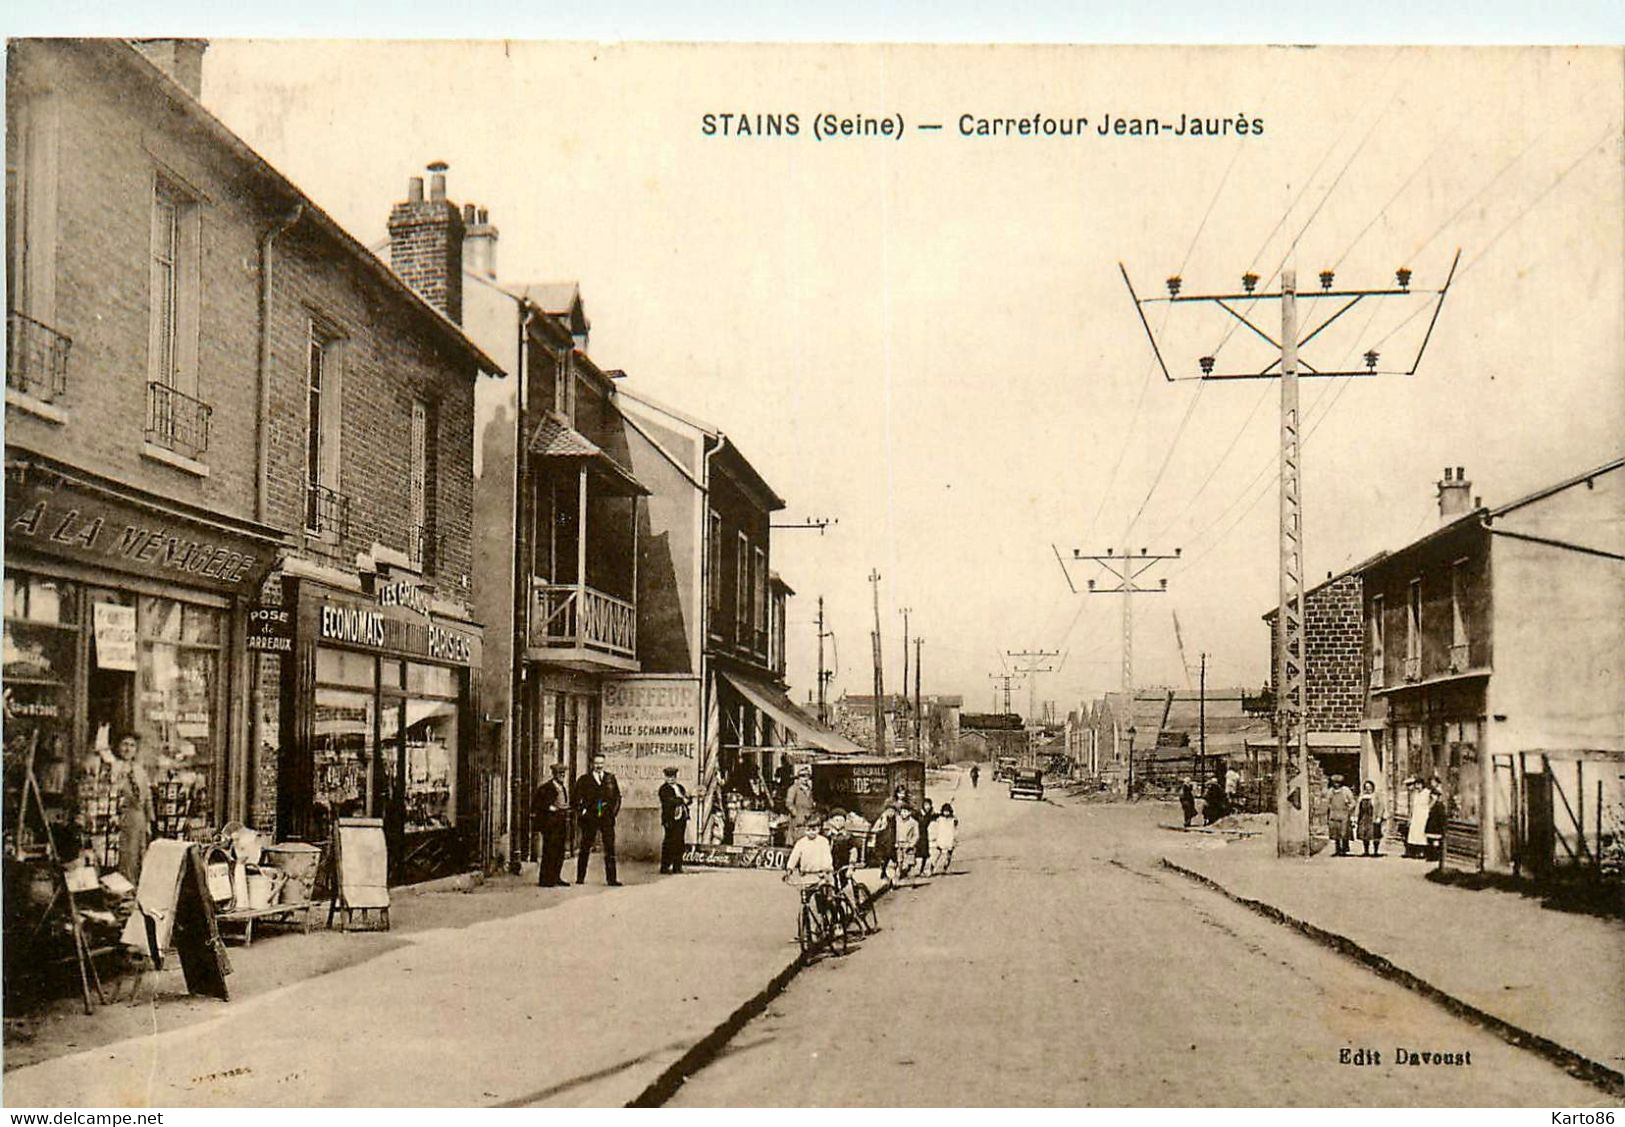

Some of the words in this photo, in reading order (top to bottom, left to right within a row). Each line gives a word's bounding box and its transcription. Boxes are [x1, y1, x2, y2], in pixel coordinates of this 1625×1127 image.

[10, 500, 47, 535] A
[50, 509, 104, 549] LA
[381, 584, 399, 606] LES
[250, 609, 289, 623] POSE
[261, 622, 275, 634] de
